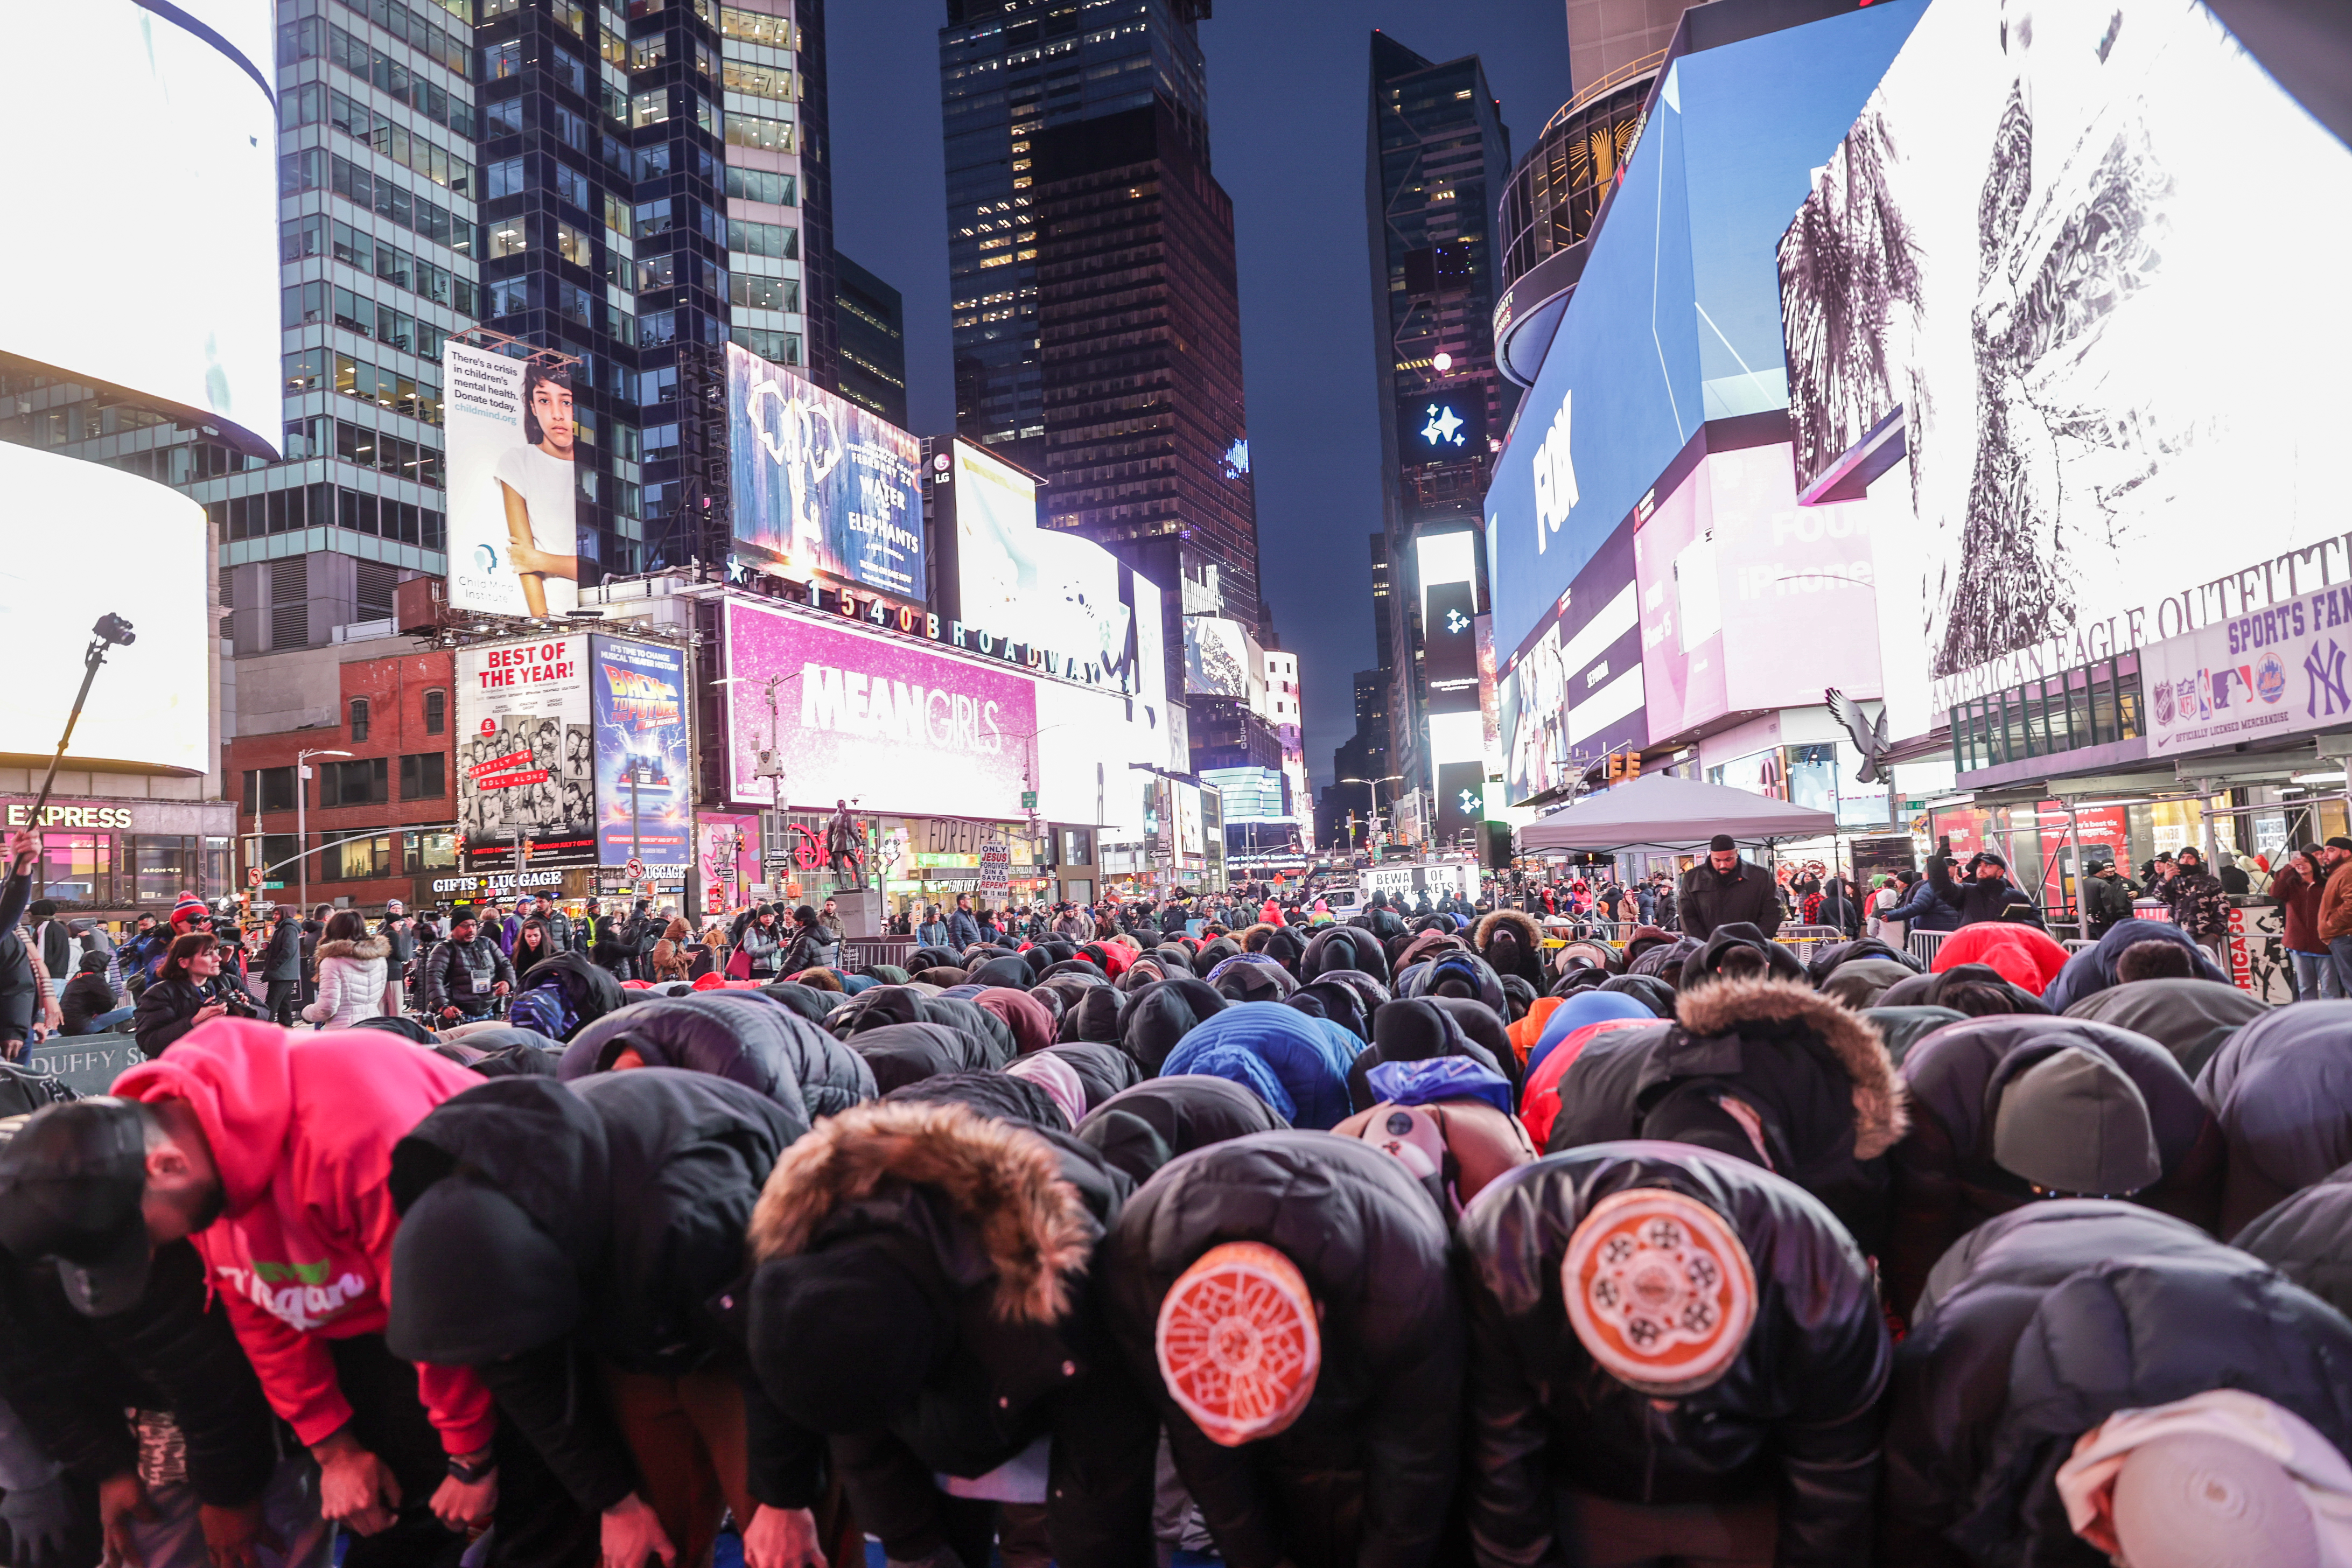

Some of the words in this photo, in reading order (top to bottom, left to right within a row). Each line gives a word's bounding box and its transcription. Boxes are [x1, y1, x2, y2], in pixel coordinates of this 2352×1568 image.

[451, 351, 485, 367] There's
[494, 365, 517, 376] crisis
[453, 364, 462, 374] in
[465, 368, 508, 386] children's
[454, 379, 485, 392] mental
[488, 385, 519, 401] health.
[454, 389, 487, 404] Donate
[489, 398, 516, 412] today.
[454, 403, 517, 426] childmind.org
[851, 452, 898, 478] FEBRUARY
[900, 473, 912, 487] 24
[935, 472, 950, 484] LG
[859, 475, 906, 510] WATER
[848, 512, 919, 554] ELEPHANTS
[459, 576, 486, 588] Child
[490, 580, 513, 592] Mind
[1738, 561, 1873, 600] iPhone
[466, 589, 508, 603] Institute
[1931, 641, 2045, 716] AMERICAN
[2053, 606, 2148, 673] EAGLE
[2158, 531, 2352, 639] OUTFITT
[2228, 601, 2305, 655] SPORTS
[488, 646, 536, 669] BEST
[541, 642, 566, 661] OF
[622, 646, 636, 656] TIME
[646, 651, 670, 662] CHANGE
[926, 612, 1100, 684] BROADWAY
[600, 651, 628, 662] MUSICAL
[628, 656, 654, 667] THEATER
[655, 662, 680, 671] HISTORY
[479, 668, 515, 688] THE
[520, 661, 573, 683] YEAR!
[601, 663, 677, 700] BACK
[612, 697, 628, 711] TO
[628, 698, 679, 720] FUTURE
[801, 662, 925, 744] MEAN
[925, 689, 1002, 755] GIRLS
[611, 711, 627, 722] THE
[2175, 727, 2208, 743] OFFICIALLY
[2210, 722, 2239, 736] LICENSED
[2241, 711, 2290, 731] MERCHANDISE
[469, 758, 510, 775] MERRILY
[516, 752, 529, 760] WE
[482, 778, 506, 787] ROLL
[514, 773, 544, 782] ALONG
[8, 804, 132, 829] EXPRESS
[533, 842, 559, 850] HROUGH
[929, 819, 995, 853] FOREVER
[982, 852, 1007, 862] JESUS
[432, 877, 478, 893] GIFTS
[488, 871, 562, 888] LUGGAGE
[948, 880, 975, 893] FOREVER
[981, 881, 1008, 889] REPENT
[1377, 872, 1410, 885] BEWA
[1431, 870, 1444, 881] OF
[2229, 908, 2252, 996] HICAGO
[31, 1050, 116, 1075] DUFFY
